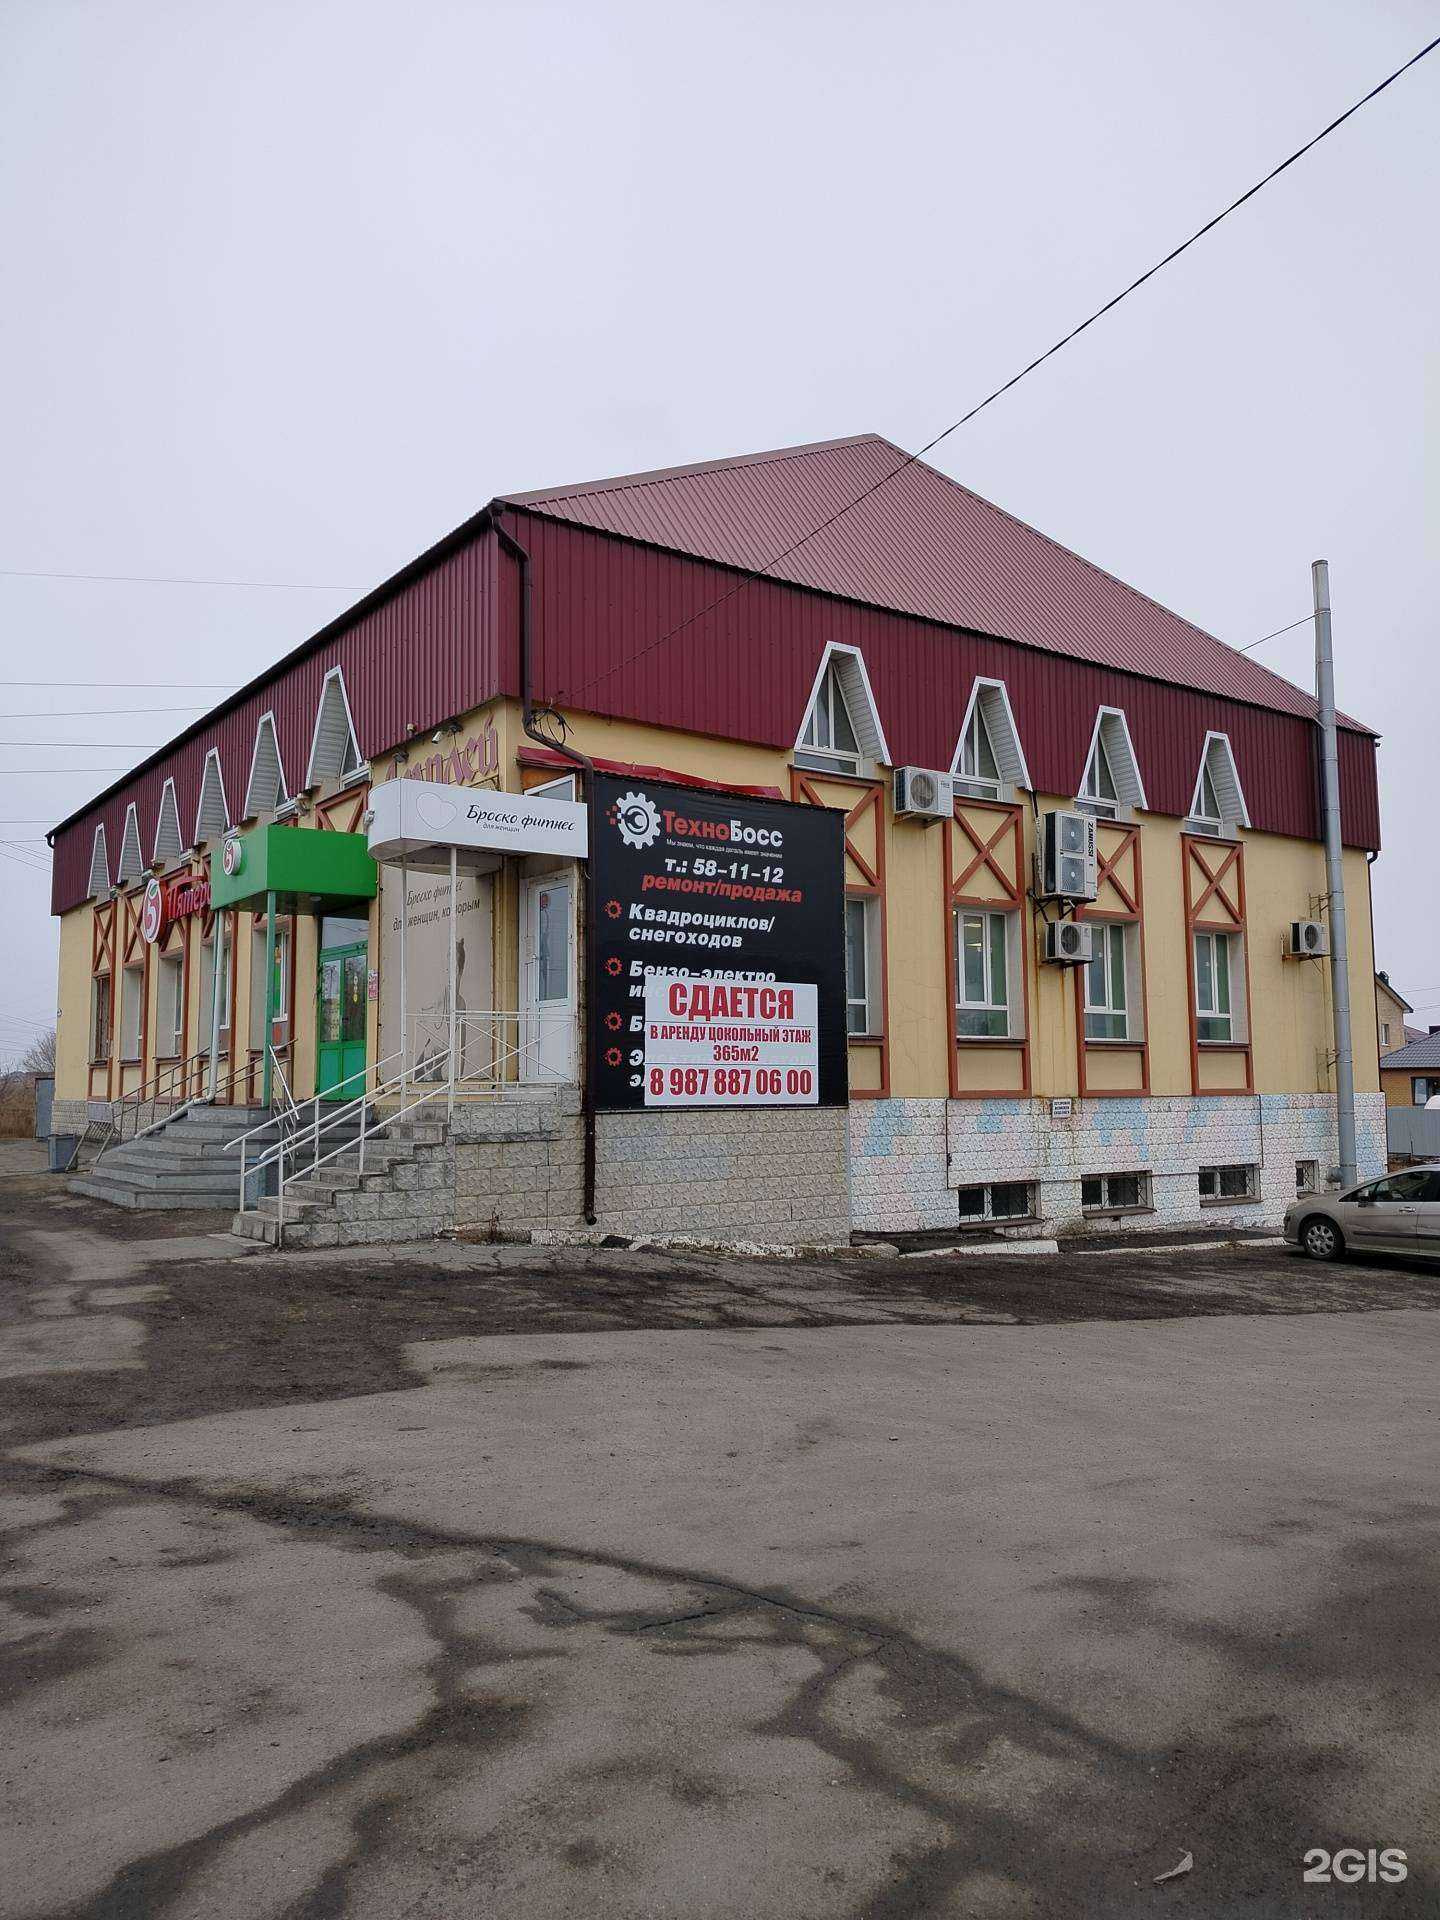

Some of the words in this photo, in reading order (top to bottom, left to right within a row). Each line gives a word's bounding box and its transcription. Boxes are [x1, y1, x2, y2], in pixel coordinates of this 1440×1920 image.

[467, 805, 518, 824] Броско
[521, 815, 576, 831] фитнес
[662, 809, 783, 847] ТехноБосс
[692, 858, 784, 883] 58-11-12
[434, 880, 463, 902] фитес
[641, 872, 802, 903] ремонт/продажа
[442, 898, 480, 916] коорым
[629, 903, 775, 932] Квадроциклов/
[629, 927, 743, 948] снегоходов
[668, 983, 793, 1021] СДАЕТСЯ
[650, 1025, 659, 1040] В
[661, 1026, 706, 1043] АРЕНДУ
[708, 1026, 780, 1043] ЦОКОЛЬНЫЙ
[782, 1029, 812, 1044] ЭТАЖ
[713, 1045, 759, 1062] 365м2
[650, 1068, 664, 1096] 8
[669, 1068, 709, 1096] 987
[713, 1068, 752, 1096] 887
[756, 1069, 782, 1095] 06
[786, 1069, 812, 1095] 00
